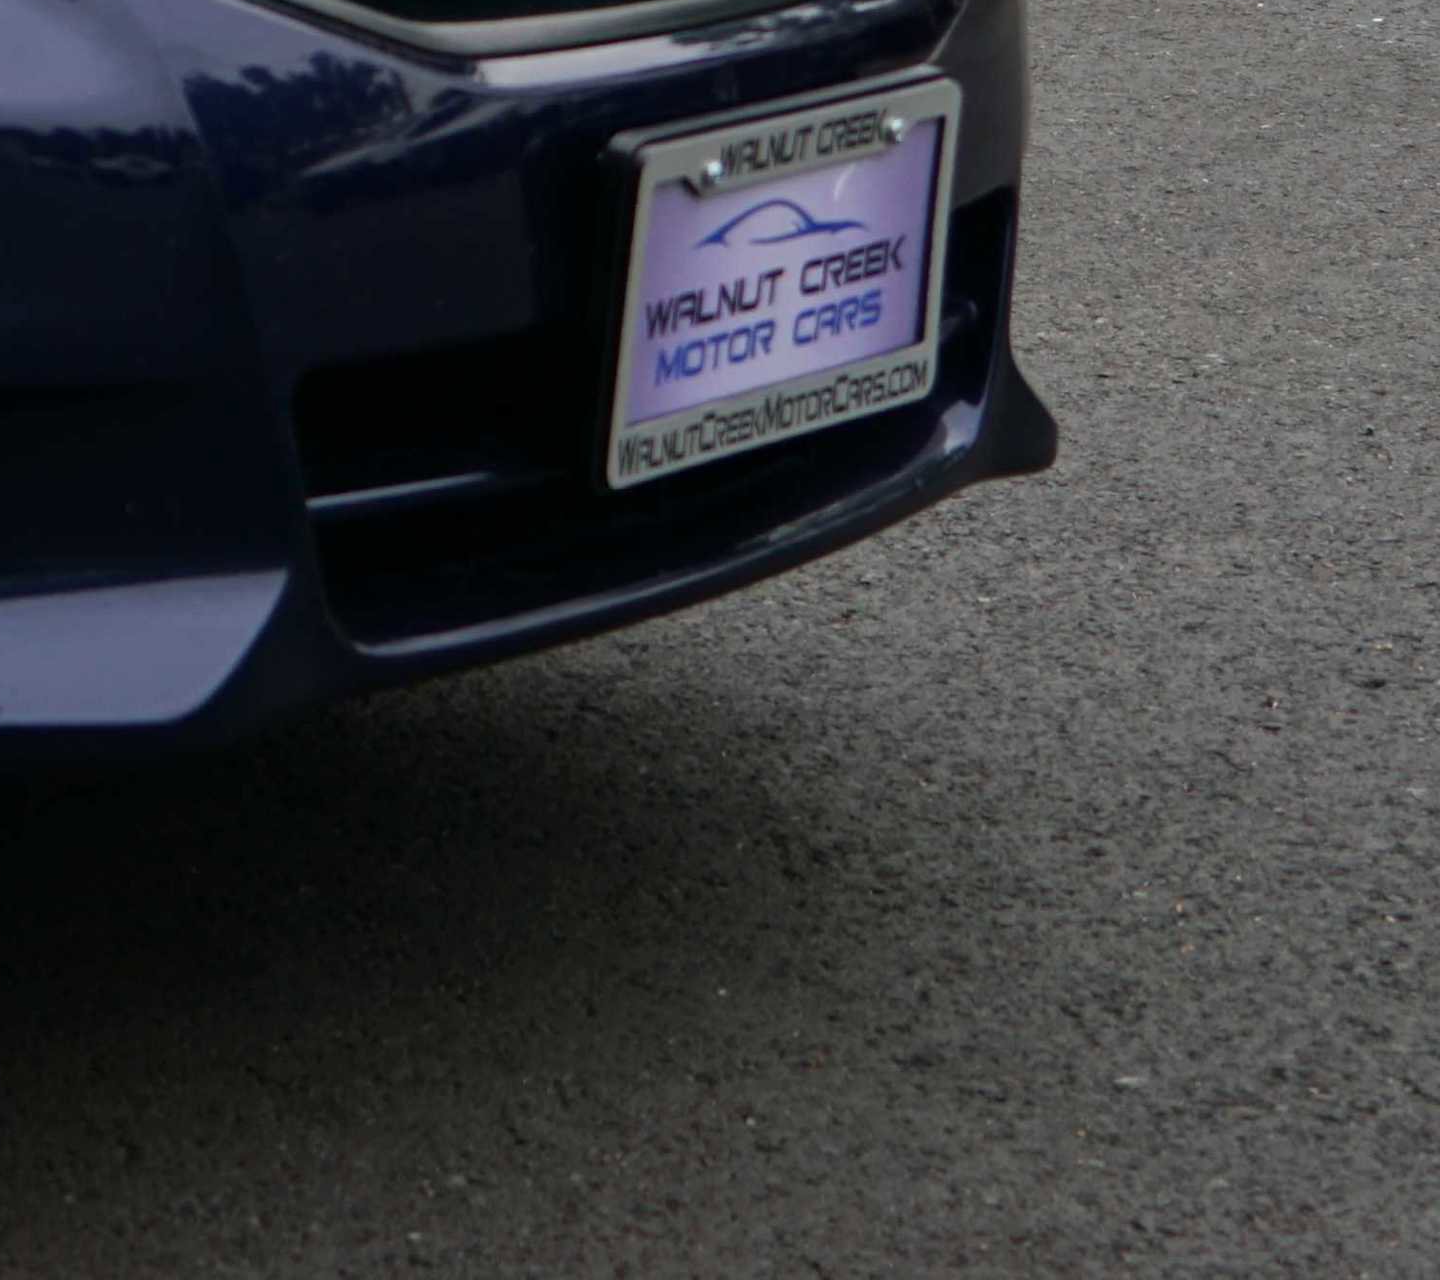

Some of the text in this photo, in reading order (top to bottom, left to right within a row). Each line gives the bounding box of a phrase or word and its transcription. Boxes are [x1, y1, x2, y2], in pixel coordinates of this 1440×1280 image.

[720, 107, 892, 176] WALNUT CREEK
[645, 234, 907, 340] WALNUT CREEK
[654, 289, 884, 387] MOTOR CARS
